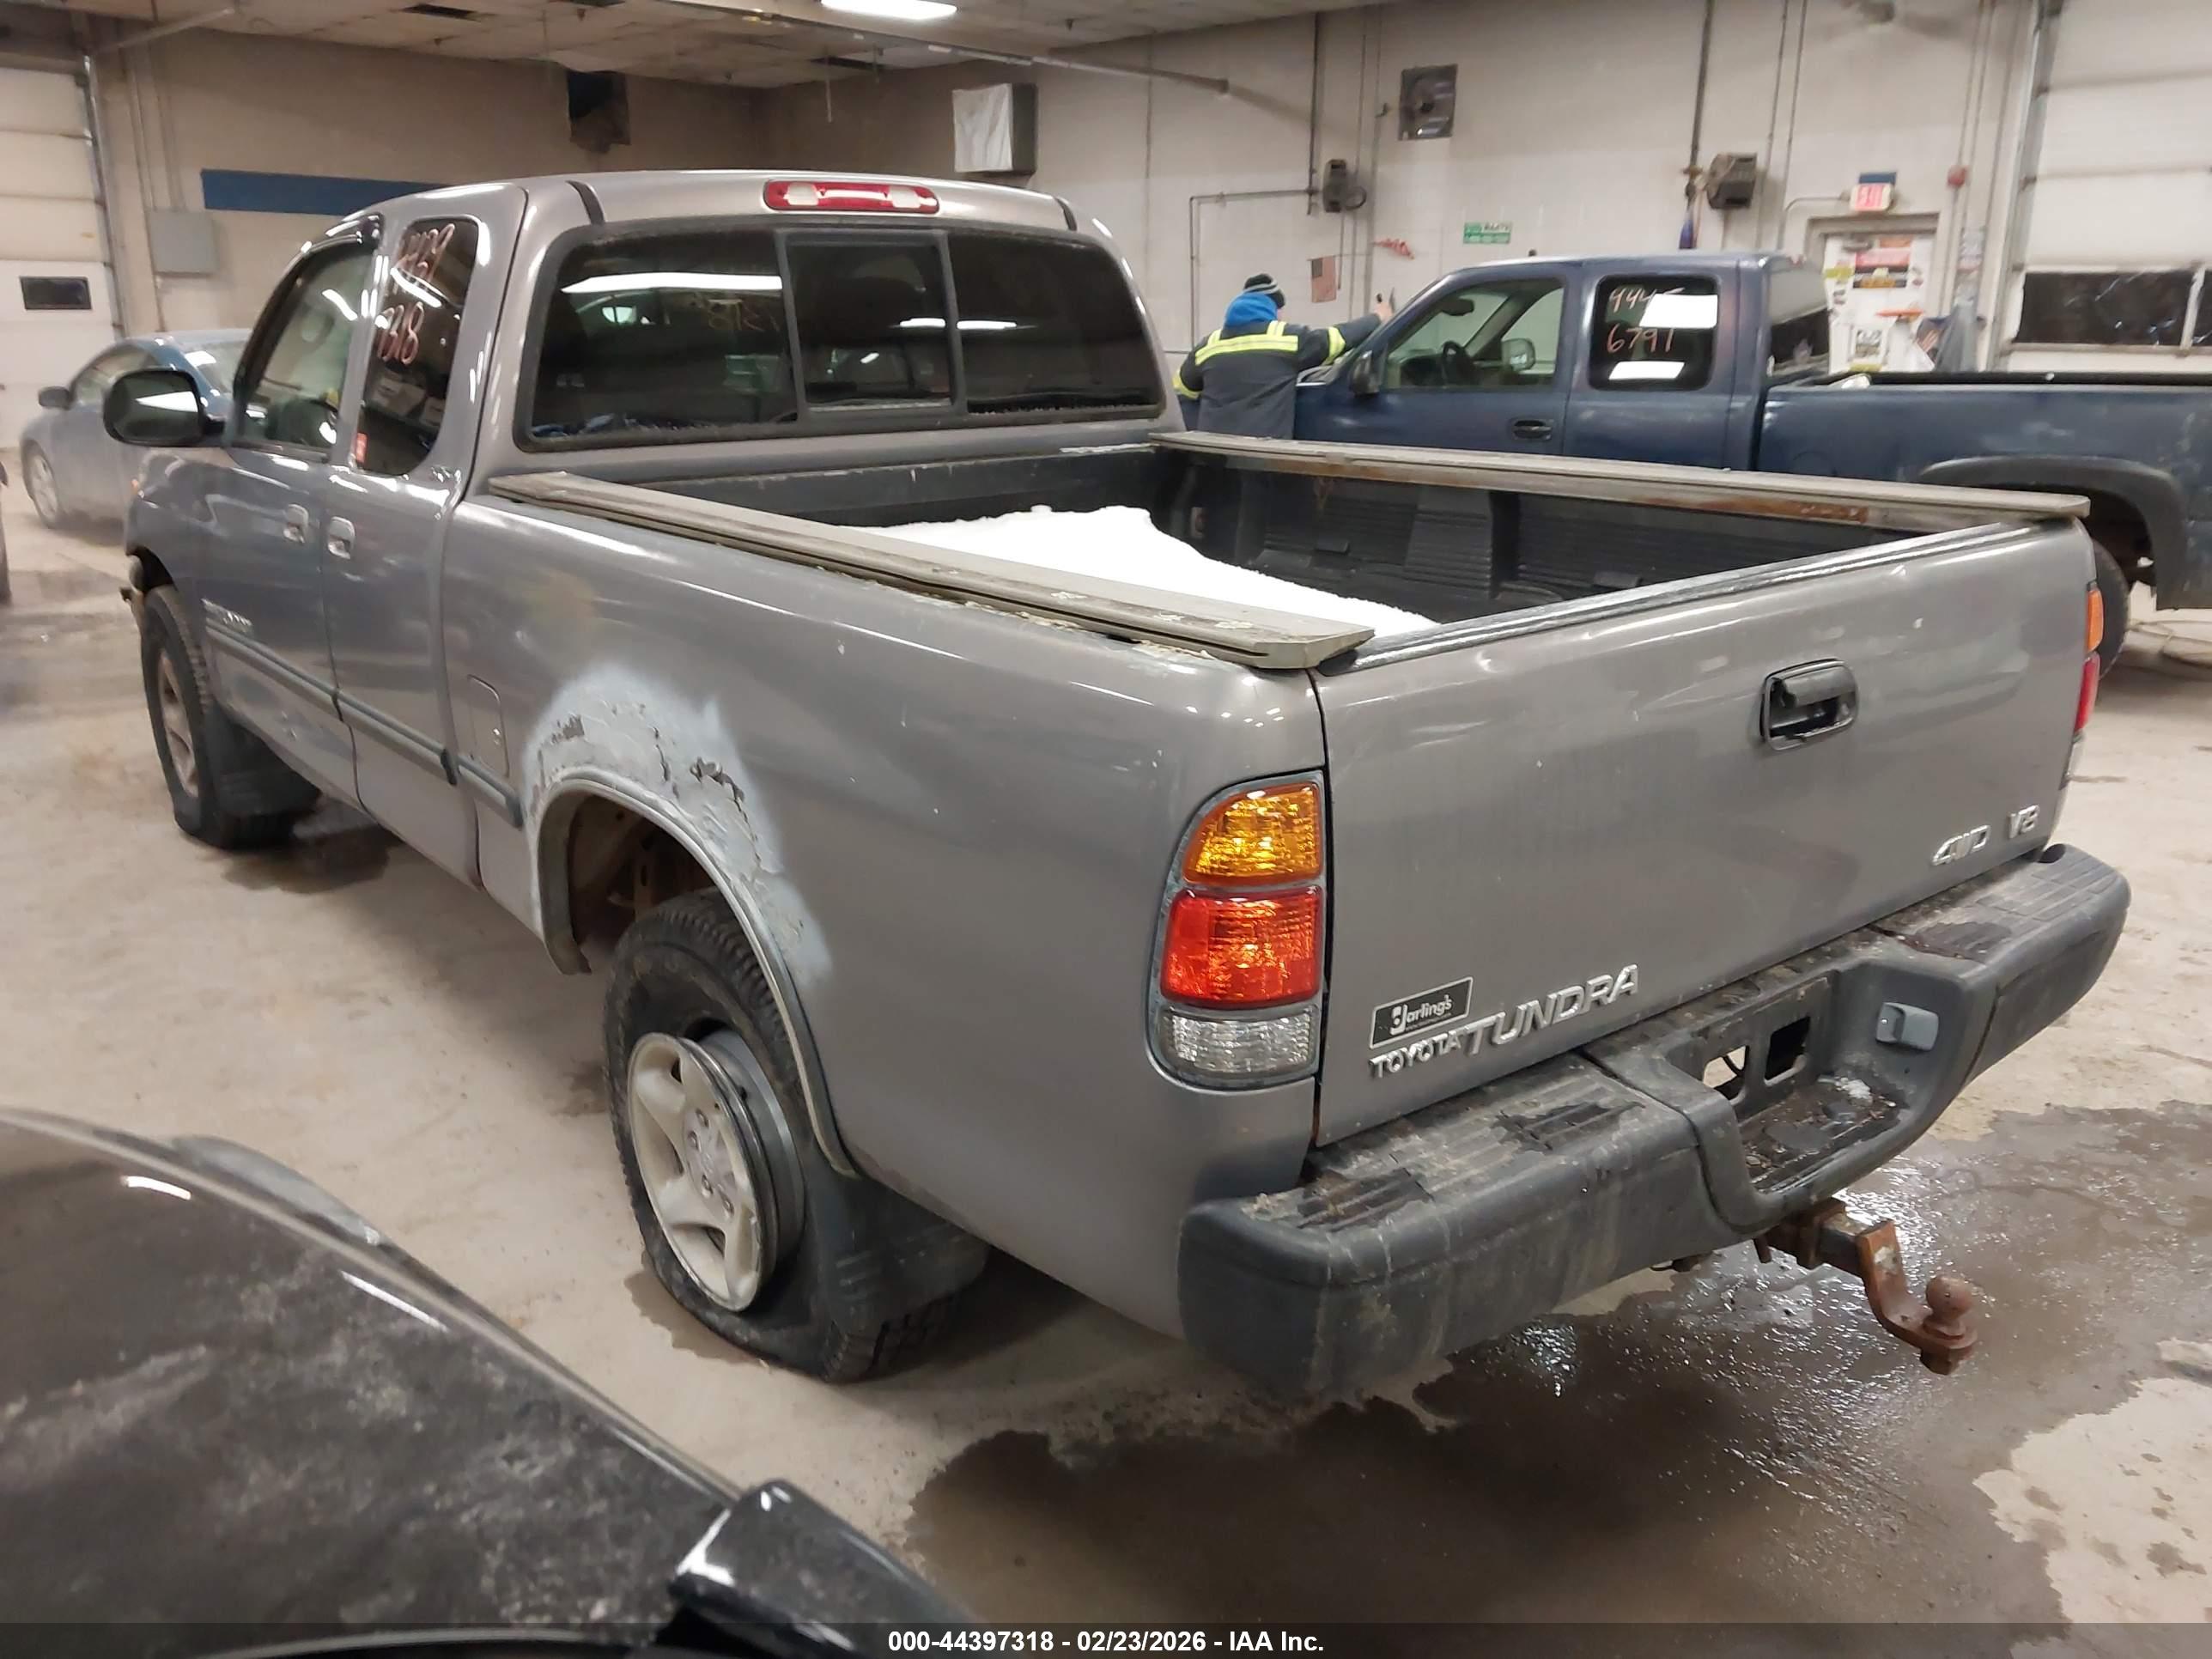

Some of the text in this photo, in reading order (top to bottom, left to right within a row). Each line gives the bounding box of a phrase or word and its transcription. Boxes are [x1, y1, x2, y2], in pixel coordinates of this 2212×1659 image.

[1607, 322, 1674, 354] 6791
[1932, 804, 2040, 866] 4WD V8
[1370, 963, 1638, 1079] TOYOTA TUNDRA
